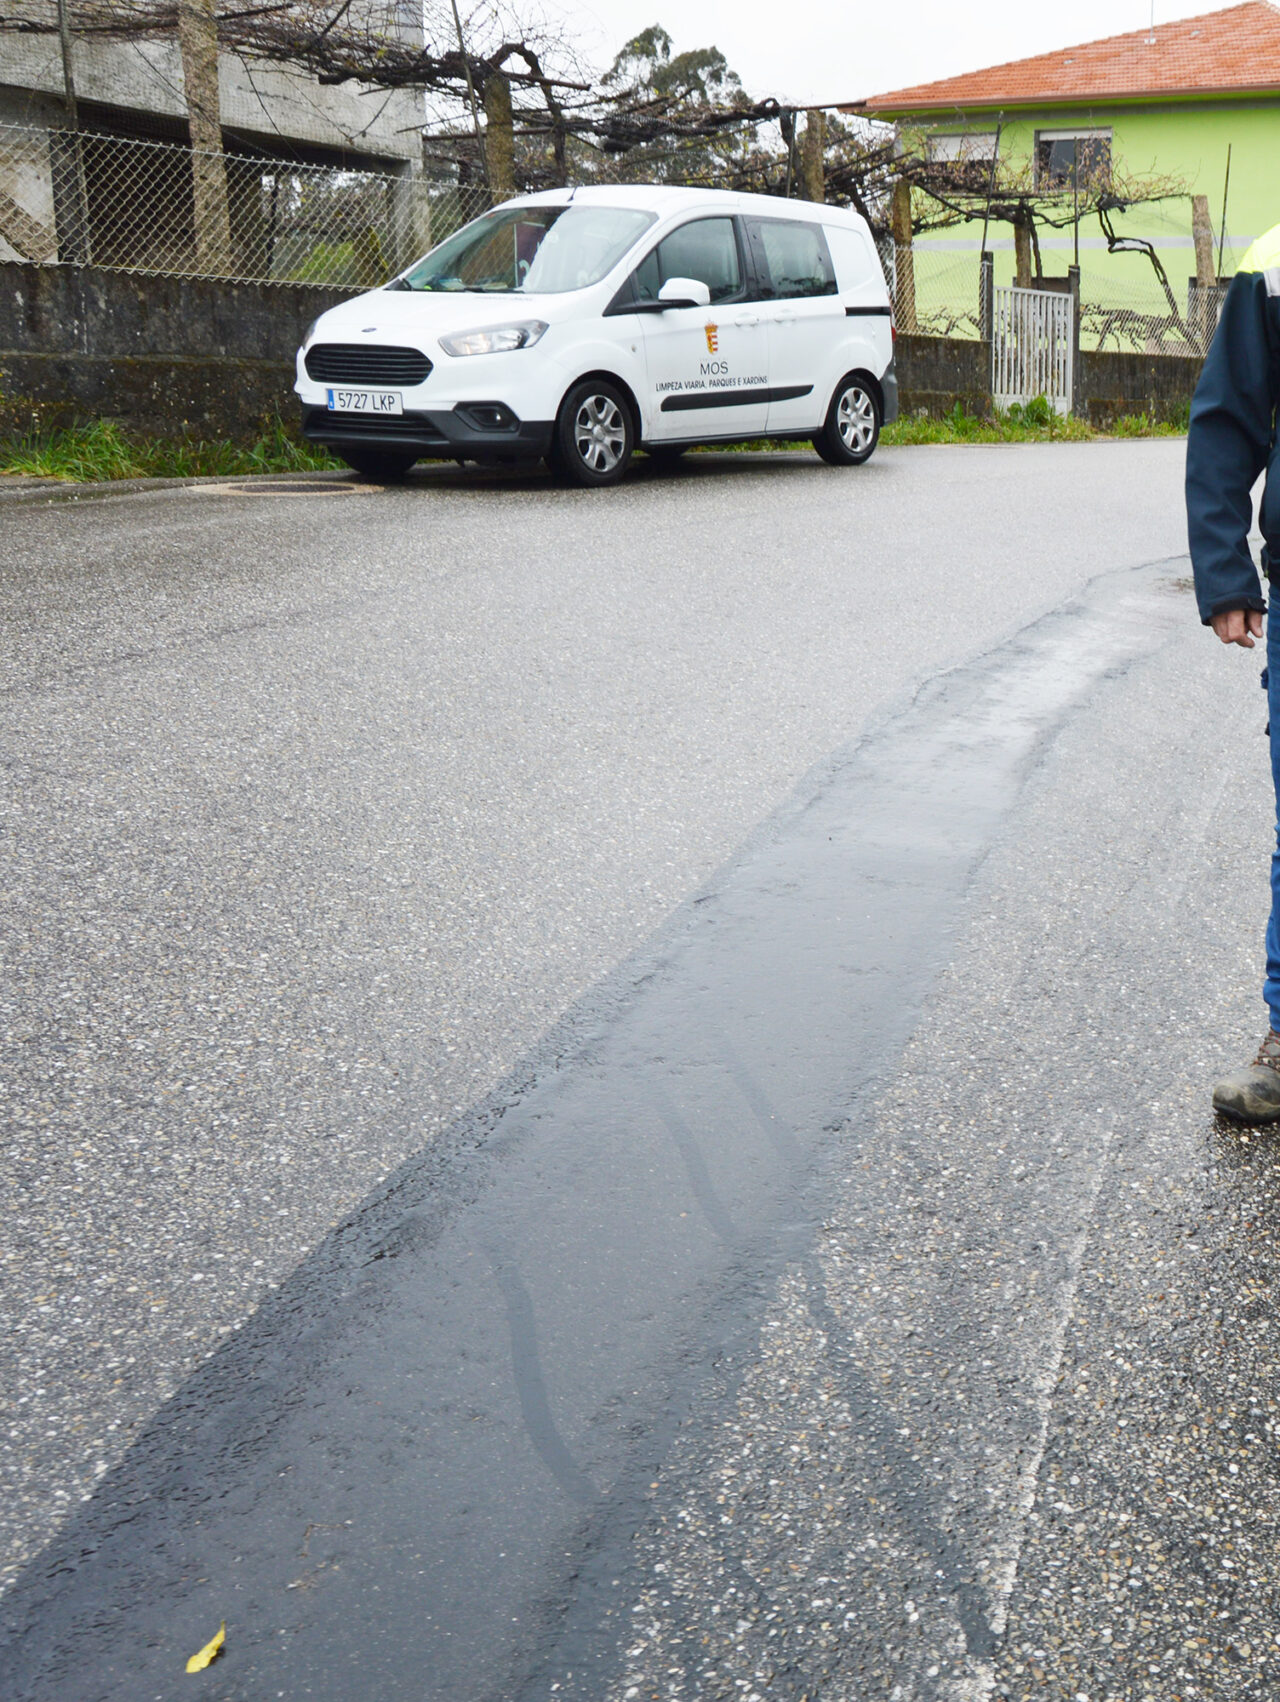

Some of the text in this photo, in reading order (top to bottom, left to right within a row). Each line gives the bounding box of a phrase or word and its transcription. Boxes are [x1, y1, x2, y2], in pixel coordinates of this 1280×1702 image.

[700, 361, 729, 376] MOS
[656, 381, 683, 392] LIMPEZA
[708, 377, 736, 388] PARQUES
[737, 377, 741, 386] E
[338, 392, 395, 411] 5727 LKP
